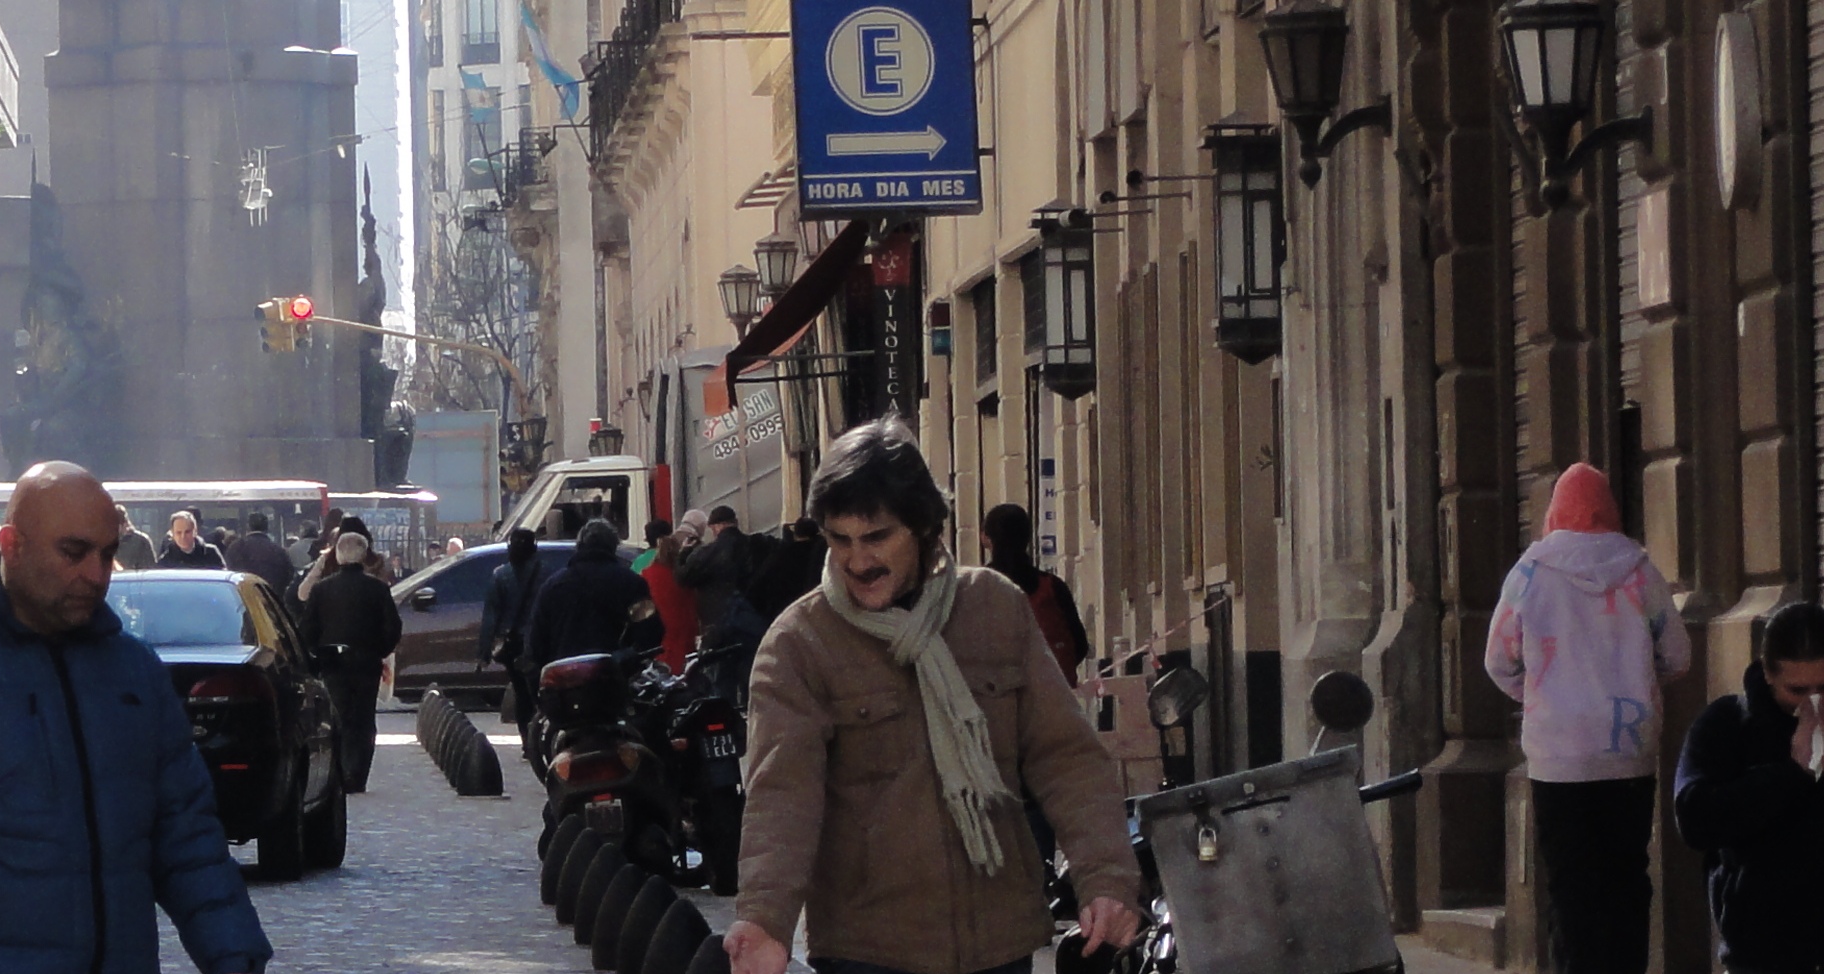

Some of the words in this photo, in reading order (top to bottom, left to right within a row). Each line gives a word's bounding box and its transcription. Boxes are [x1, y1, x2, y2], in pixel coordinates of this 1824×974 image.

[857, 24, 903, 98] E
[808, 182, 863, 198] HORA
[877, 181, 909, 197] DIA
[923, 179, 966, 196] MES
[884, 289, 900, 411] VINOTECA
